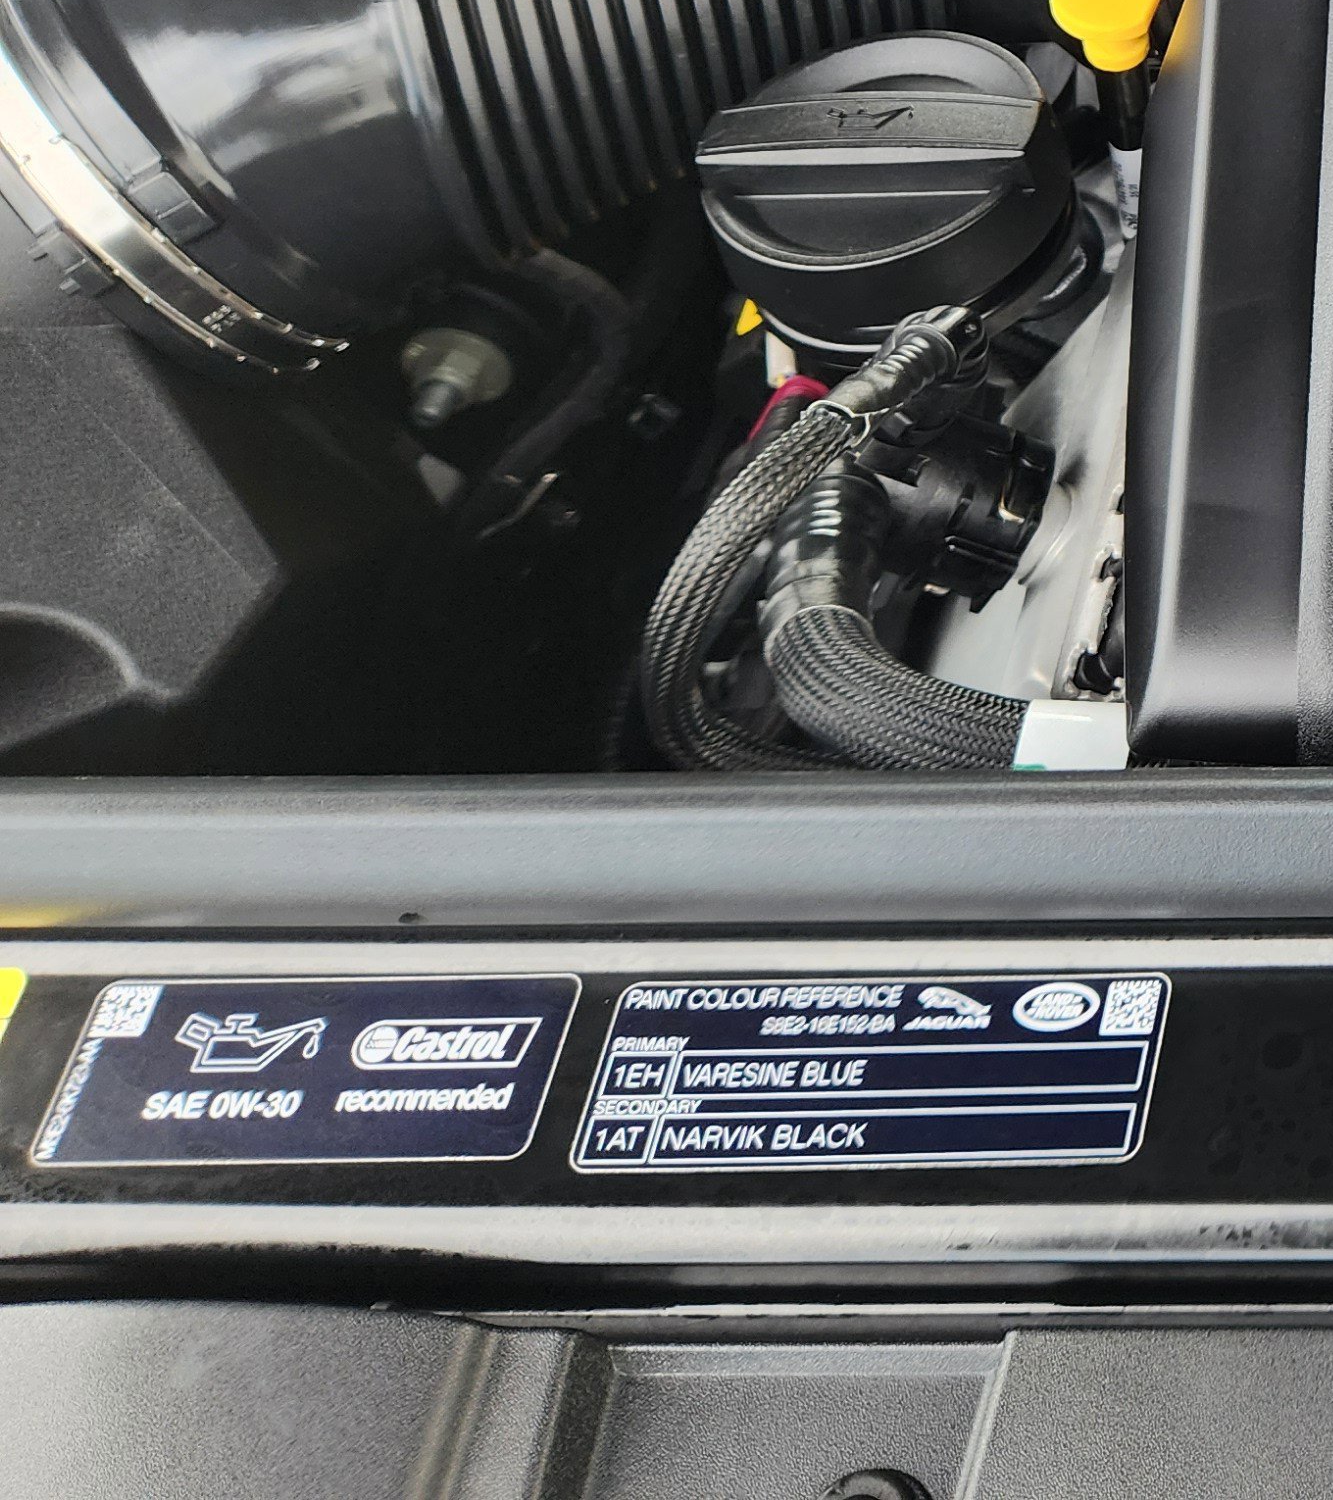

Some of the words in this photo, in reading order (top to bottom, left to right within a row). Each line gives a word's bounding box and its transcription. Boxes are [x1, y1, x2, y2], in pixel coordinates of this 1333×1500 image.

[624, 988, 690, 1011] PAINT
[687, 986, 780, 1011] COLOUR
[778, 984, 905, 1010] REFERENCE
[1031, 992, 1074, 1007] LAND
[902, 1015, 991, 1031] JAGUAR
[1033, 1003, 1085, 1021] ROVER
[391, 1023, 518, 1062] Castrol
[610, 1036, 690, 1051] PRIMARY
[613, 1062, 667, 1089] 1EH
[682, 1059, 801, 1088] VARESINE
[799, 1058, 869, 1088] BLUE
[141, 1091, 208, 1120] SAE
[209, 1090, 303, 1119] 0W-30
[335, 1082, 515, 1112] recommended
[592, 1099, 703, 1116] SECONDARY
[595, 1125, 647, 1152] 1AT
[658, 1123, 767, 1151] NARVIK
[769, 1121, 869, 1150] BLACK
